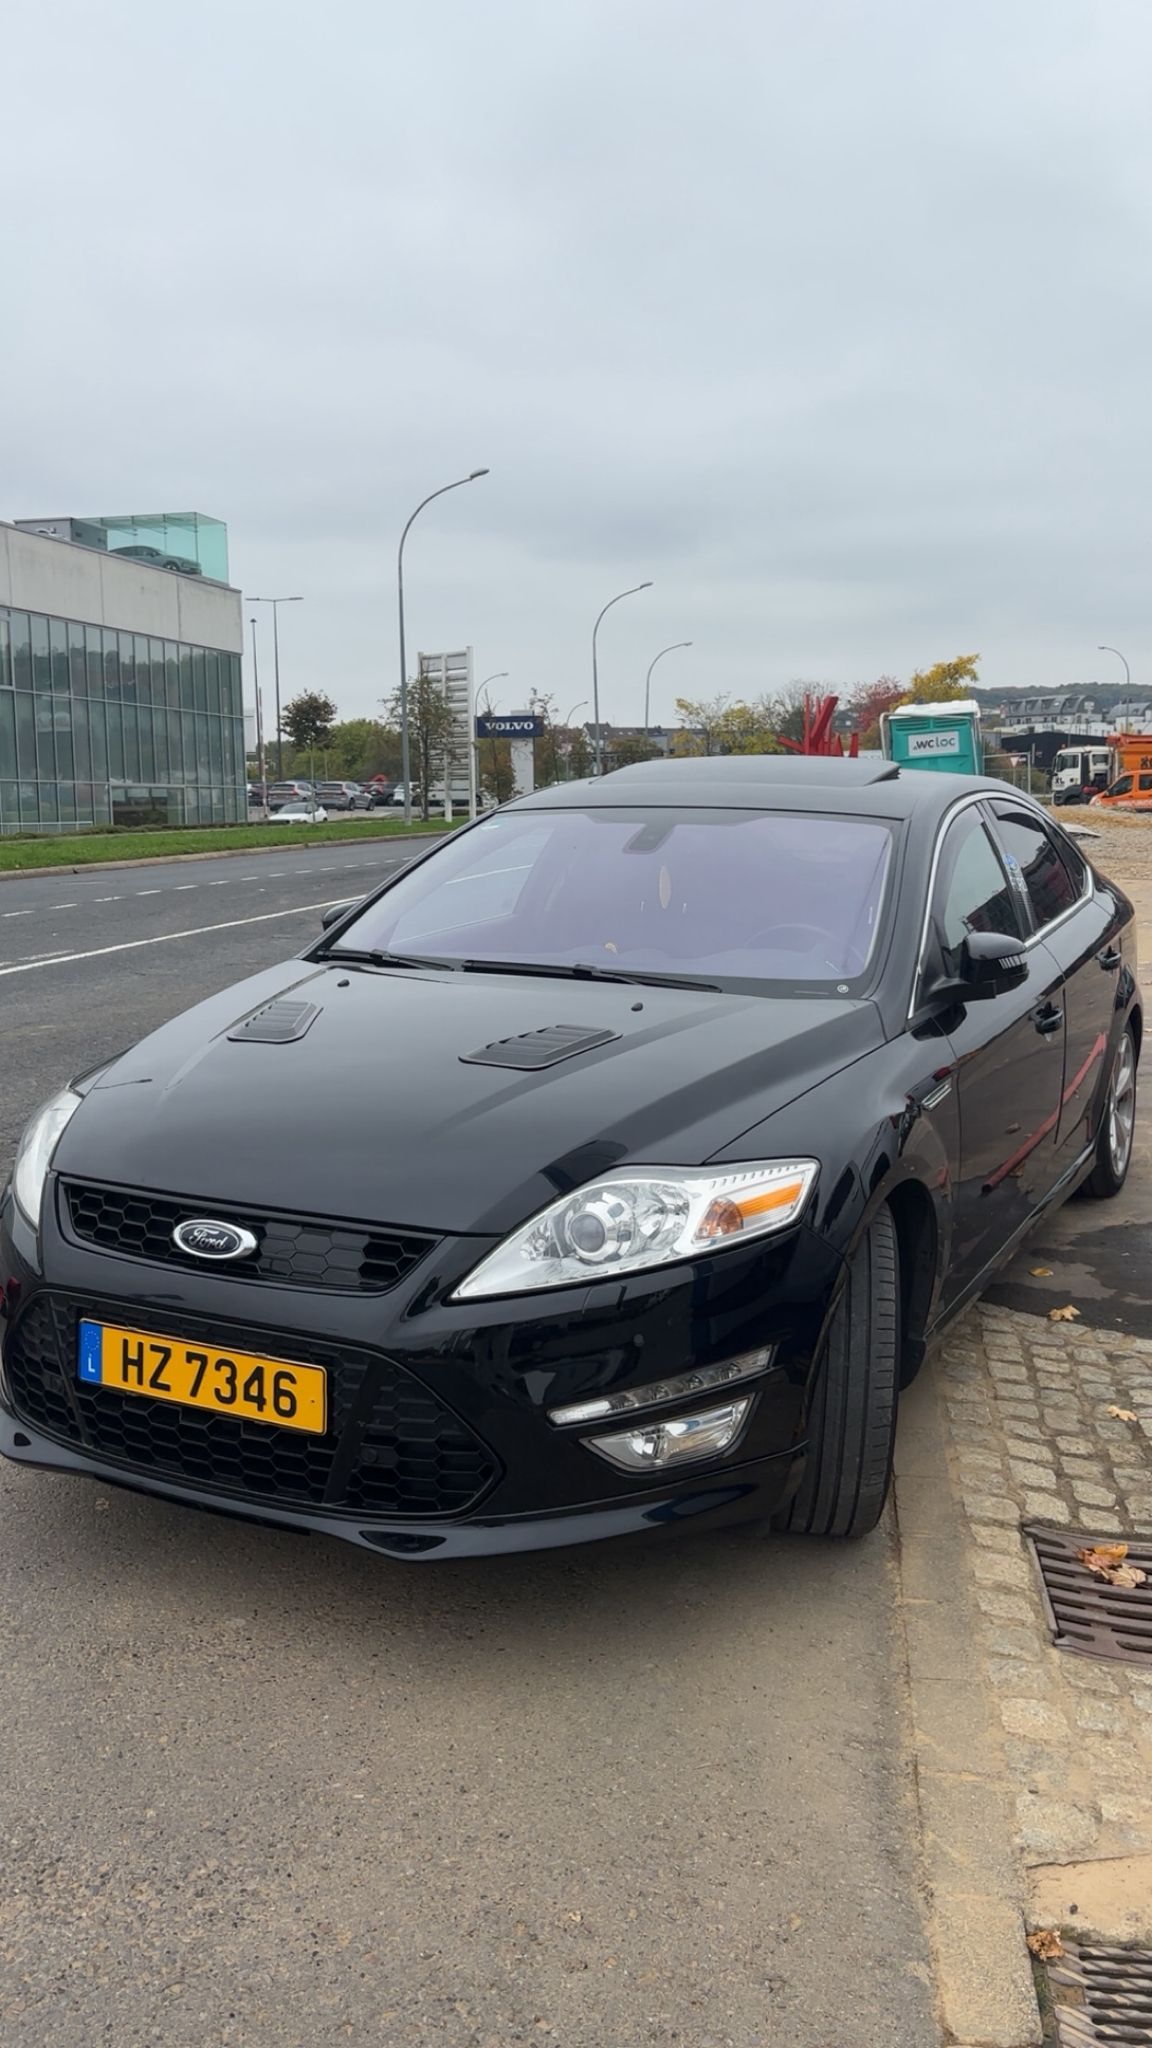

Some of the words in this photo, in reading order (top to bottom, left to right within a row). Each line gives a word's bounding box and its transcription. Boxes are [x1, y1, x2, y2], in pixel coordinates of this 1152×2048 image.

[485, 721, 534, 730] VOLVO
[189, 1227, 229, 1249] Ford
[88, 1356, 95, 1373] L
[122, 1338, 172, 1392] HZ
[185, 1351, 297, 1419] 7346
